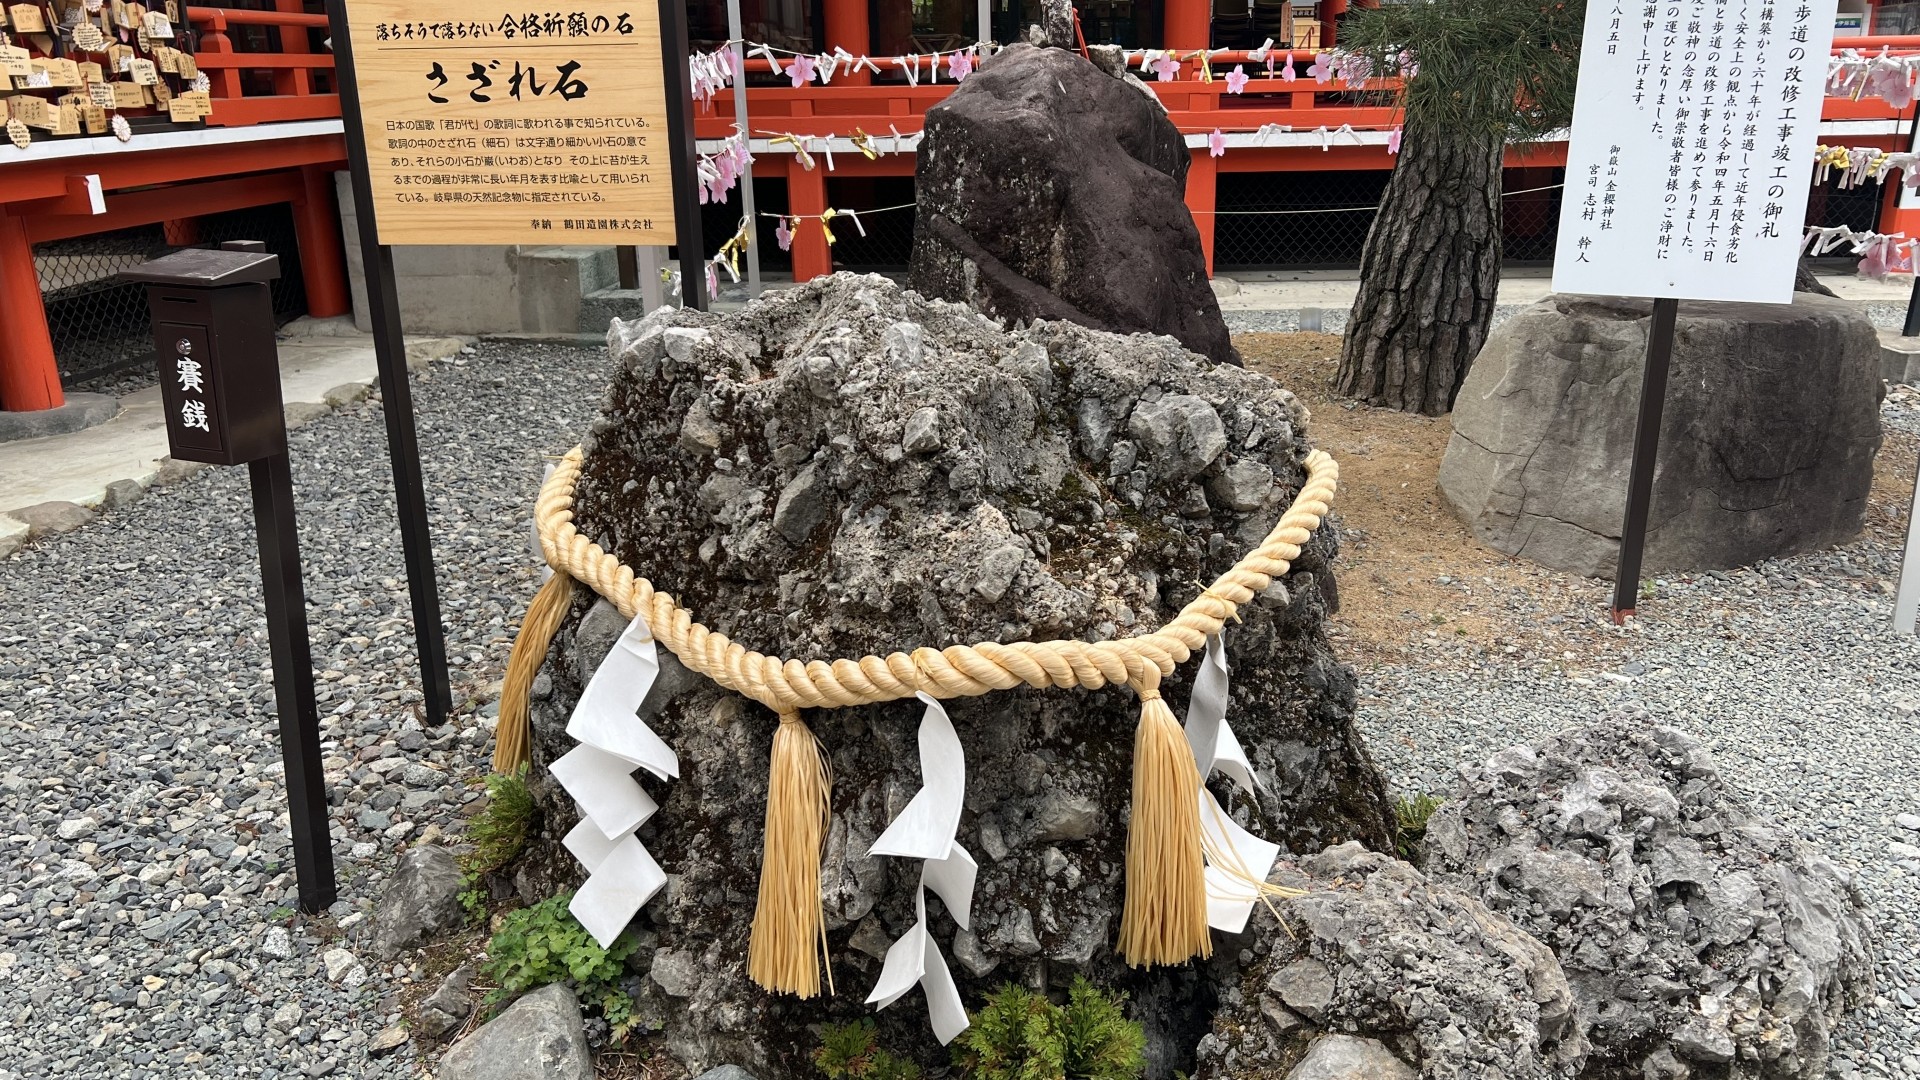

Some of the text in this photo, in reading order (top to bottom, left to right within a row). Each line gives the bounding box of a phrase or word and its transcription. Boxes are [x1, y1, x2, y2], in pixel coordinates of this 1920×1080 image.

[1606, 0, 1624, 55] 八月五日
[426, 60, 589, 103] さざれ石
[1651, 0, 1682, 141] の運びとなりました。
[386, 117, 650, 131] 日本の国歌「君が代」の歌詞に歌われる事で知られている。
[531, 218, 552, 230] 奉納
[1581, 193, 1597, 221] 志村
[1575, 236, 1592, 263] 幹人
[176, 356, 210, 433] 賽銭
